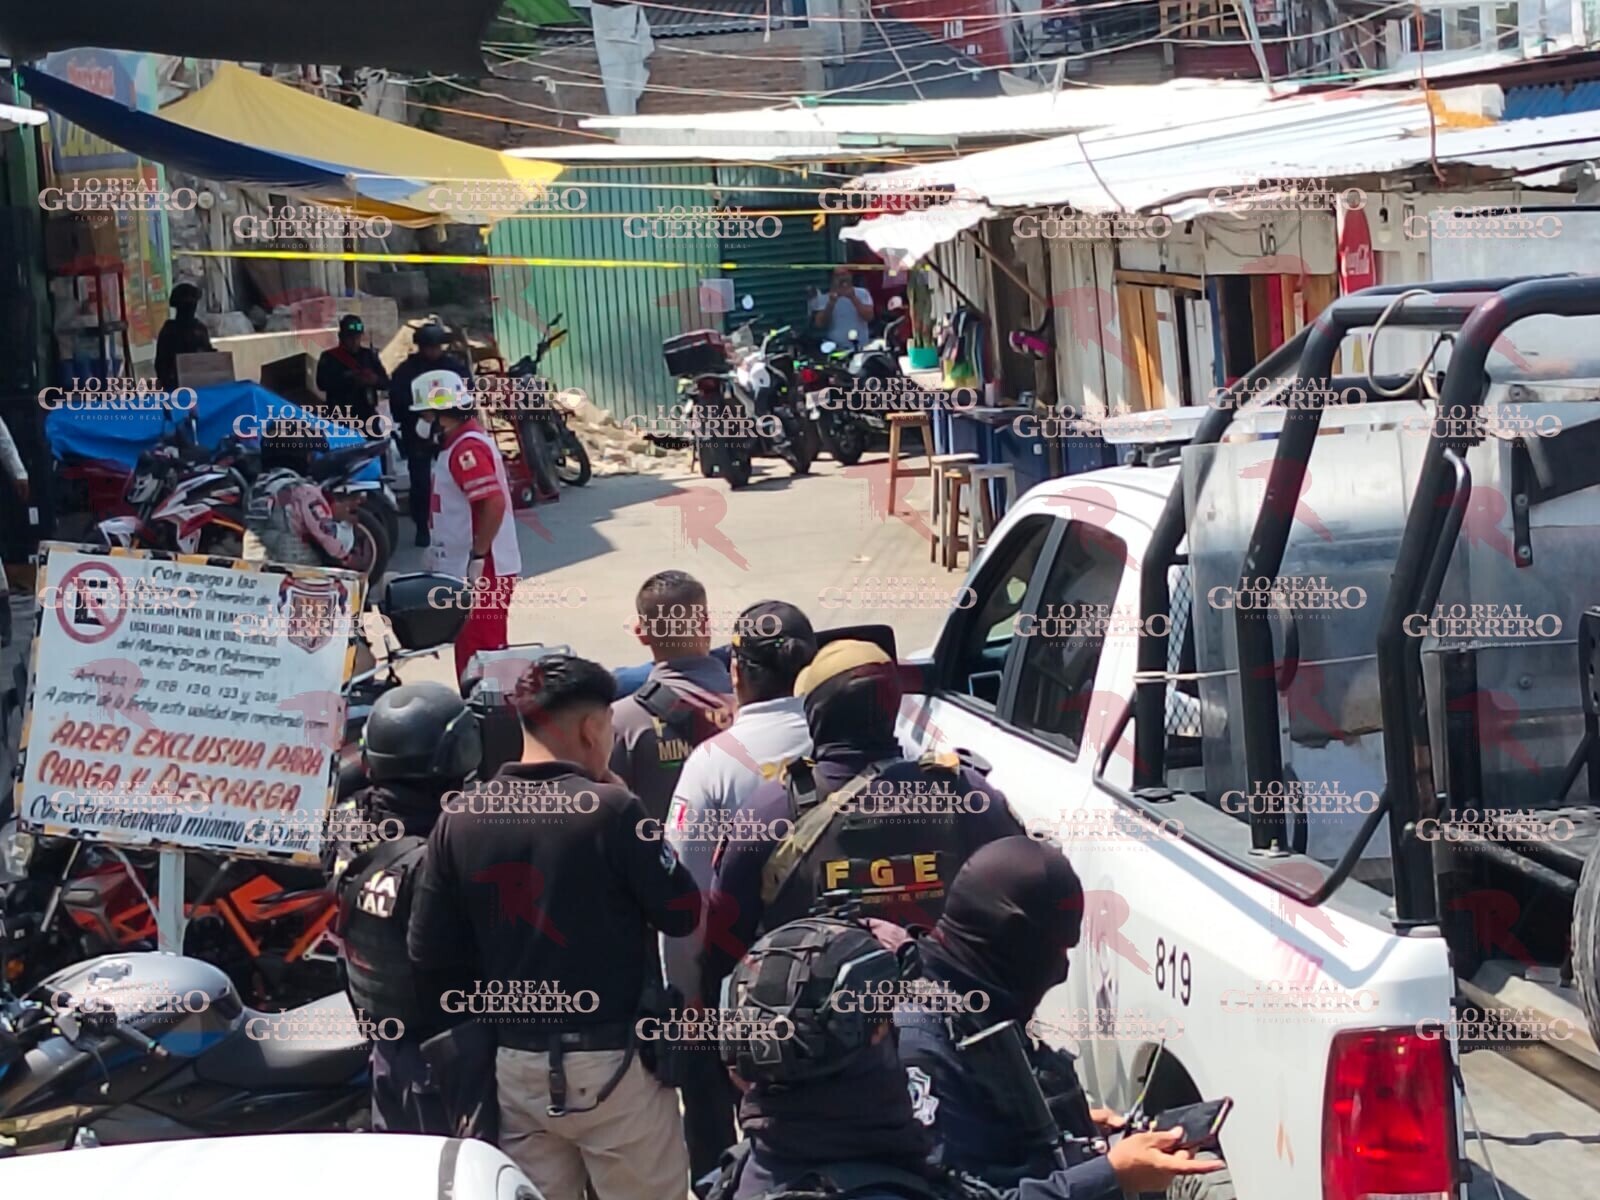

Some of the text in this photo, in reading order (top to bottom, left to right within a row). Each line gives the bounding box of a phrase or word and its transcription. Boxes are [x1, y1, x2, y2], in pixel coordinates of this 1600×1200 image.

[186, 571, 224, 588] apego
[237, 574, 257, 589] las
[177, 625, 202, 640] PARA
[37, 750, 121, 791] CARGA
[266, 741, 325, 778] PARA
[1154, 937, 1192, 1007] 819
